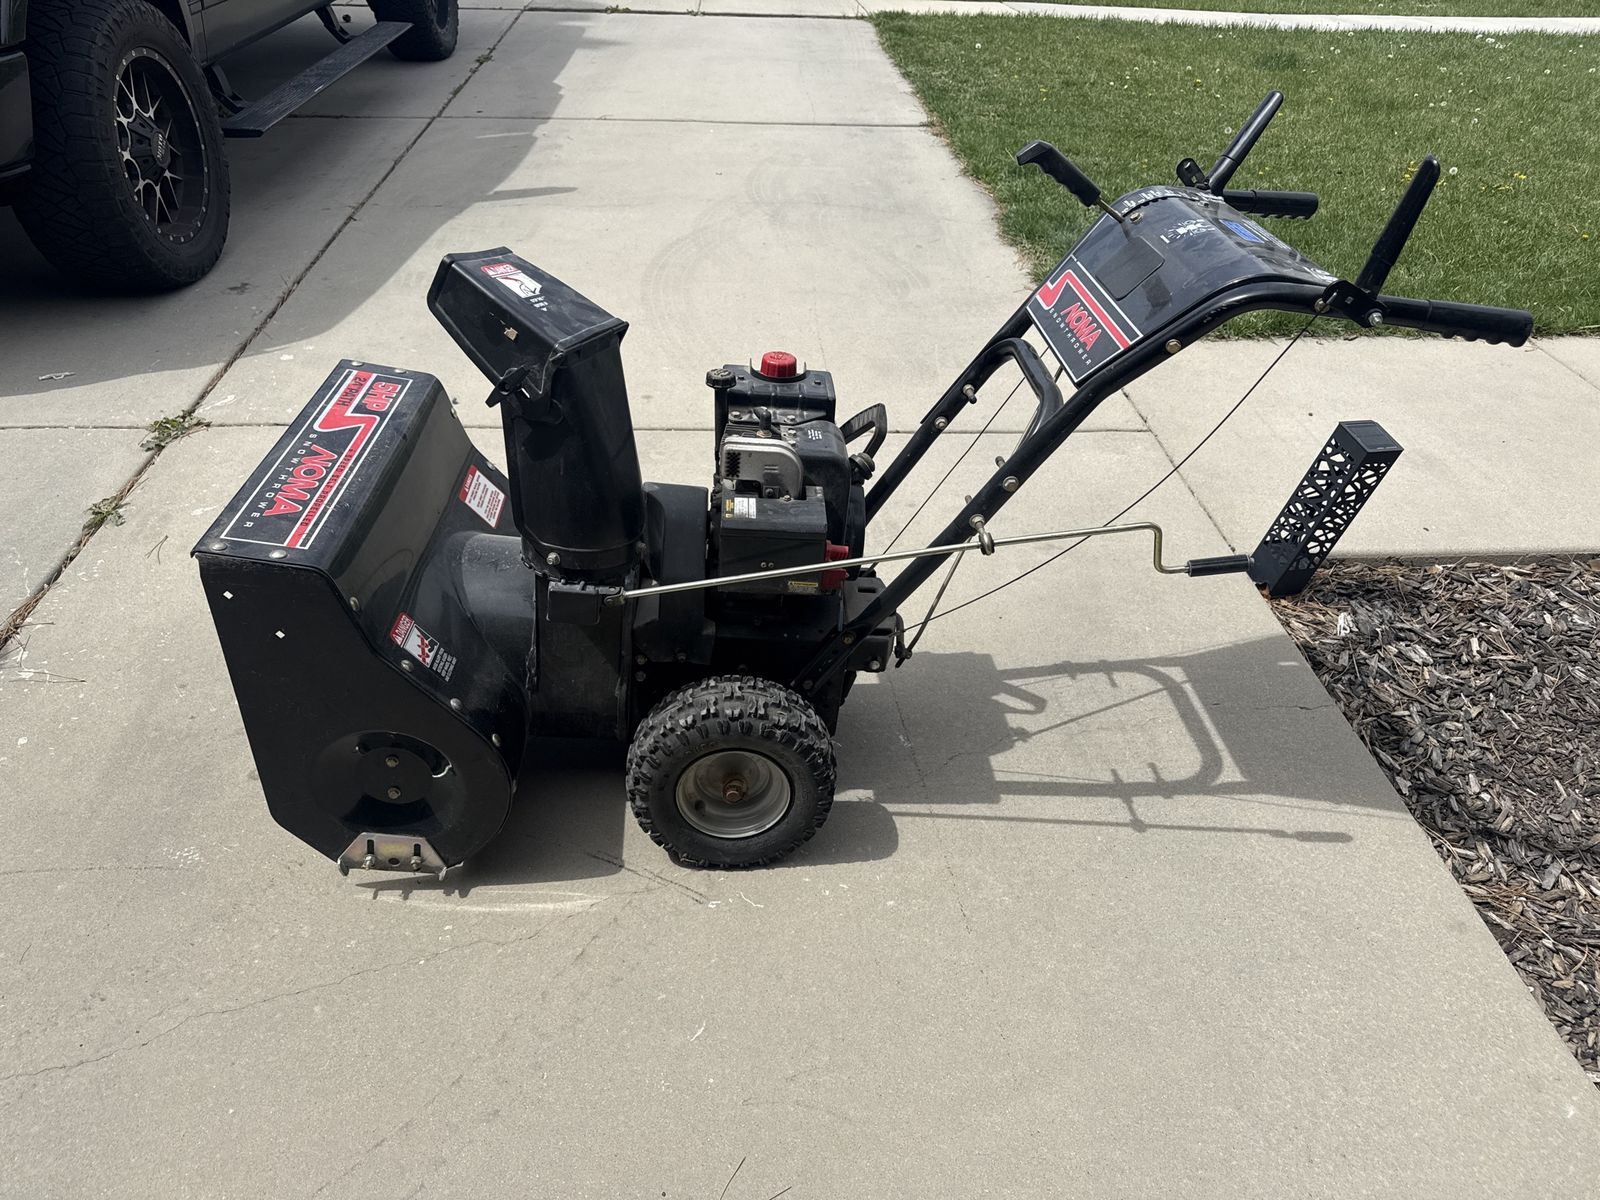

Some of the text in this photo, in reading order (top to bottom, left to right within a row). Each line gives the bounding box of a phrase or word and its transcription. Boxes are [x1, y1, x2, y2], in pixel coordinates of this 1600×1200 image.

[1048, 307, 1092, 365] SNOWTHROWER
[1060, 301, 1103, 351] NOMA
[336, 388, 358, 406] PATH
[362, 381, 402, 412] 5HP
[242, 433, 318, 528] SNOWTHROWER
[262, 444, 338, 517] NOMA
[325, 474, 339, 489] SELF
[394, 614, 412, 638] DANGER
